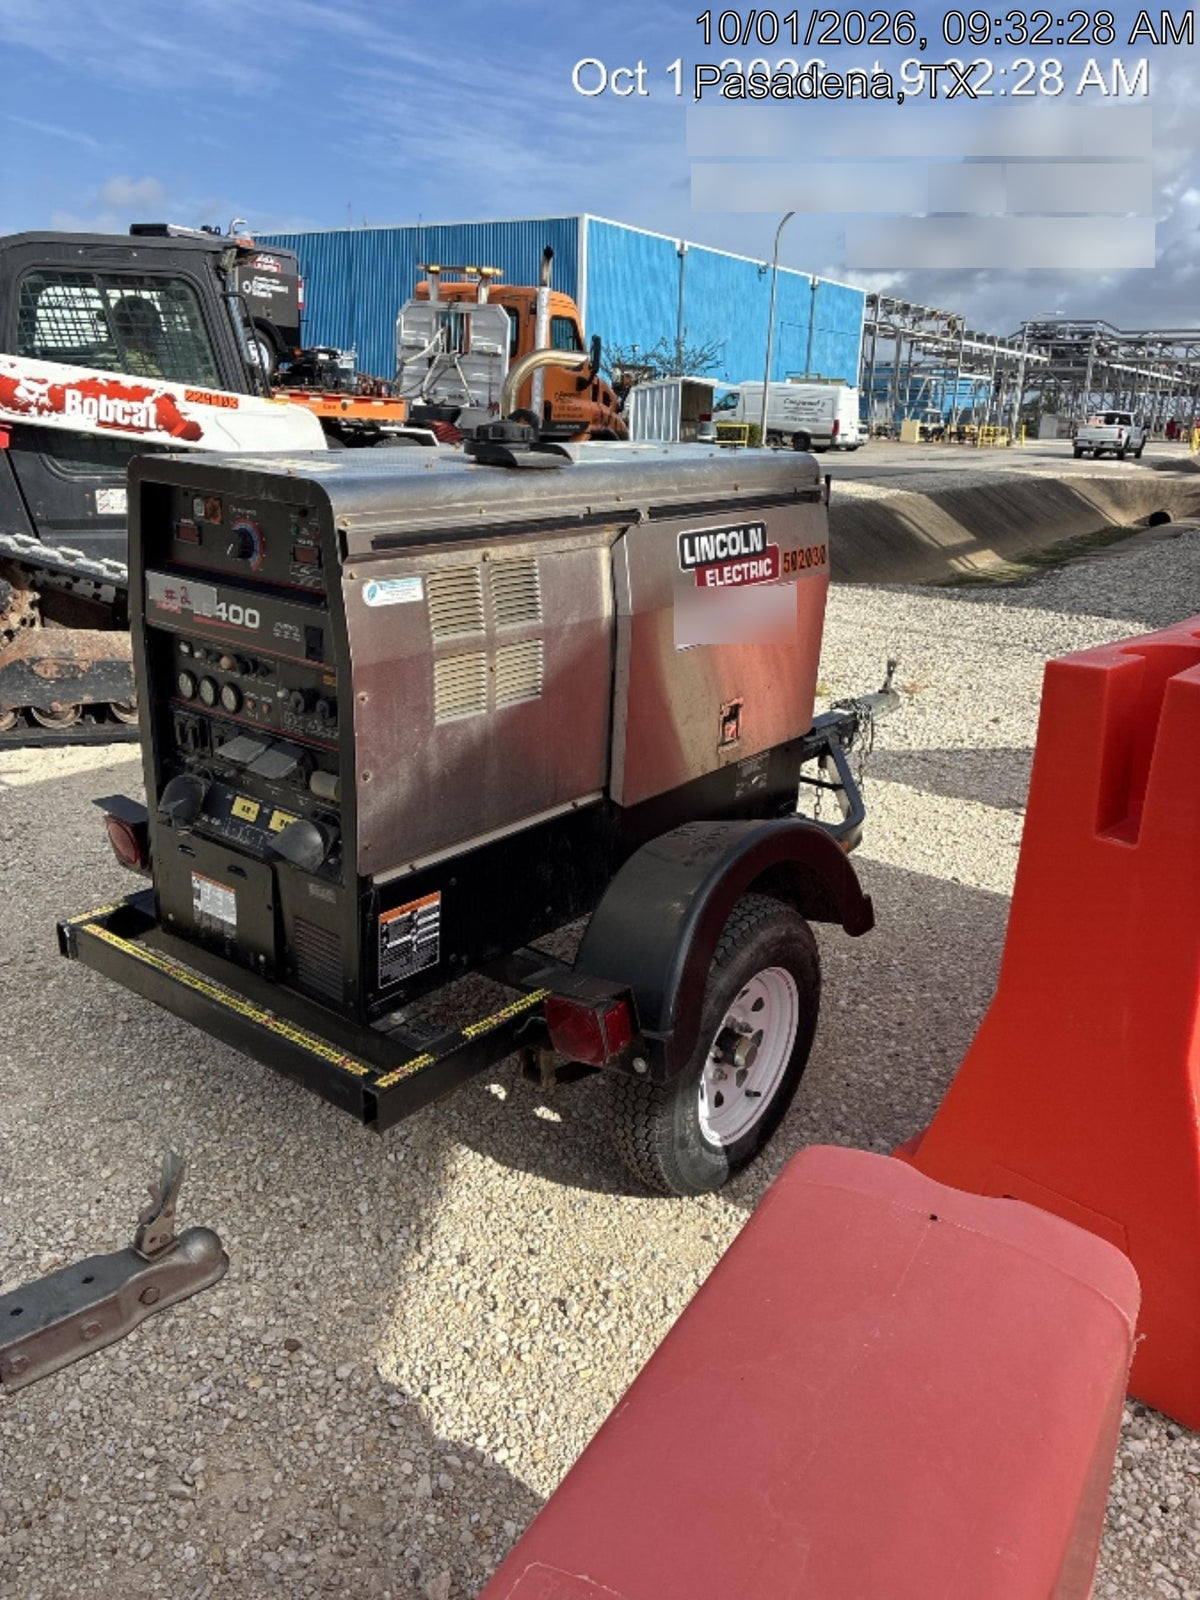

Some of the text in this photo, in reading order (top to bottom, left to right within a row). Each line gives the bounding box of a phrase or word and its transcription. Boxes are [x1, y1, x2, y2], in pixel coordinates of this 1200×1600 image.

[65, 389, 157, 429] Bobcat
[185, 389, 238, 409] 229103
[683, 527, 763, 564] LINCOLN
[783, 545, 826, 573] 502030
[705, 558, 773, 586] ELECTRIC
